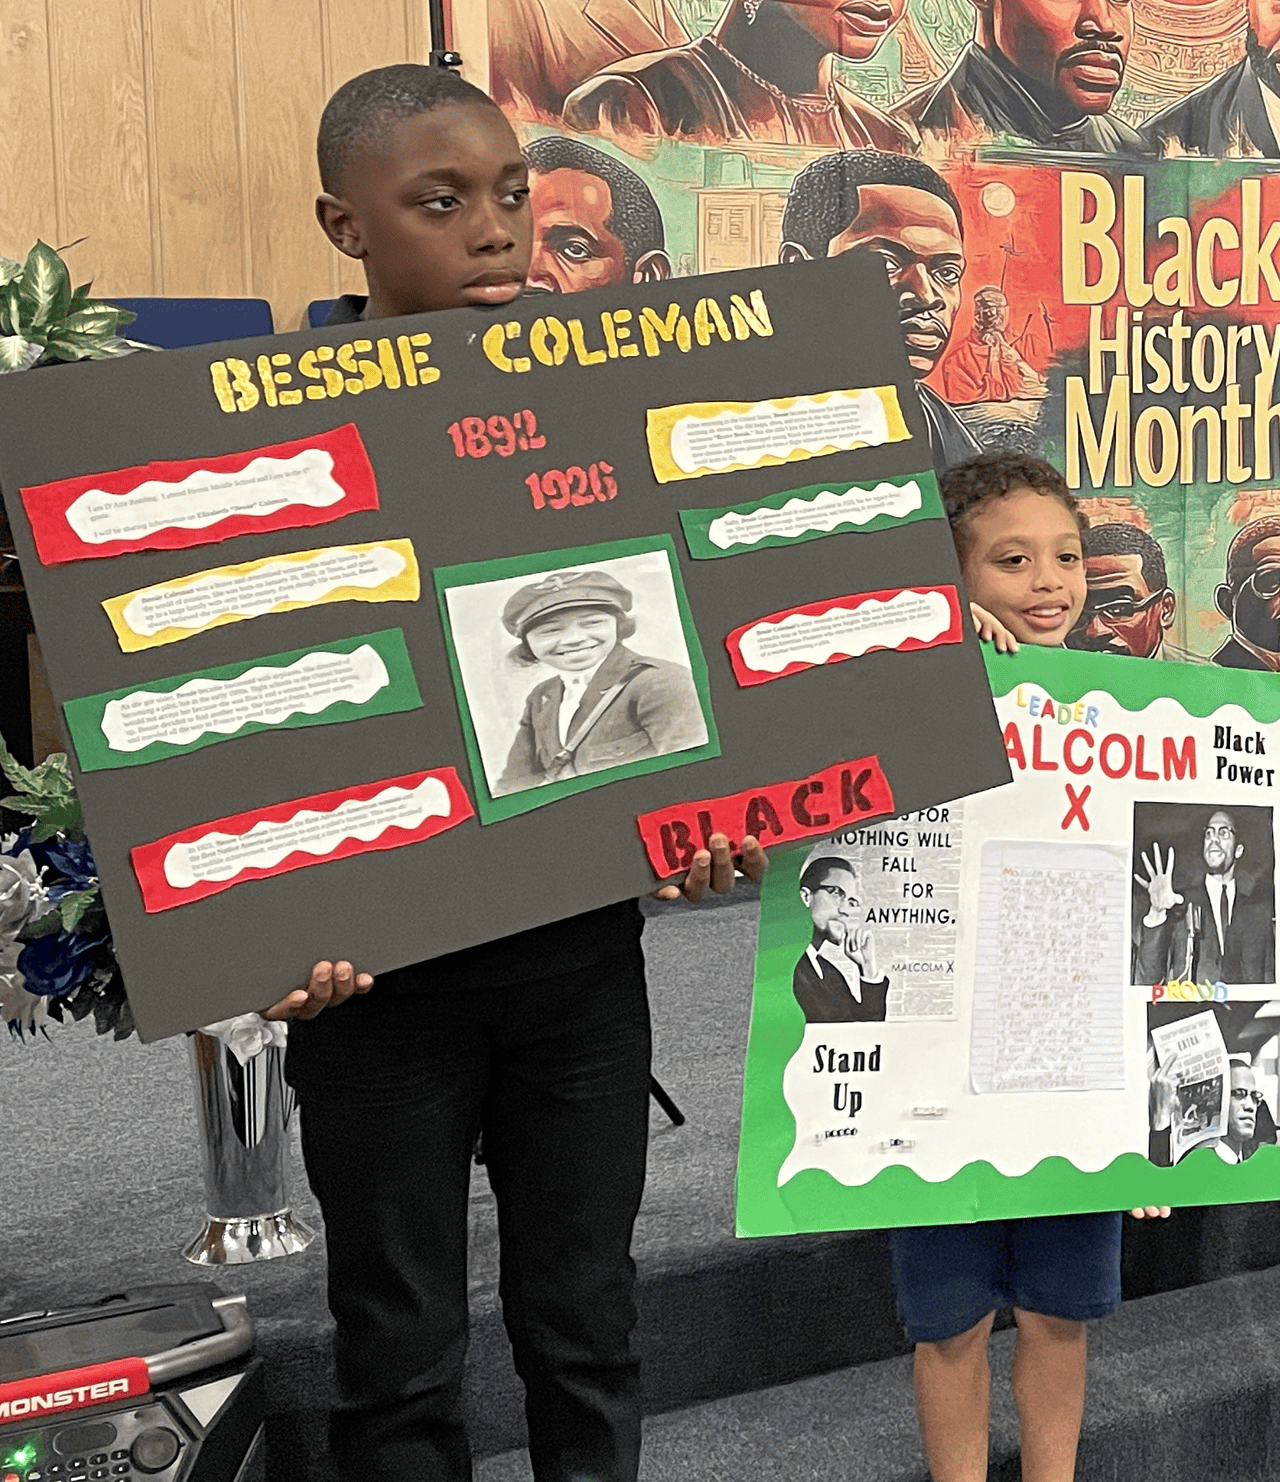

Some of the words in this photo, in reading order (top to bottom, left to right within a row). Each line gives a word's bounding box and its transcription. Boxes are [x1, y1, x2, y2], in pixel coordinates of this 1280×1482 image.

[209, 332, 441, 414] BESSIE
[482, 289, 775, 373] COLEMAN
[447, 409, 547, 459] 1892
[524, 461, 619, 511] 1926
[1017, 687, 1099, 728] LEADER
[1003, 722, 1197, 781] ALCOLM
[1213, 725, 1266, 755] Black
[1216, 756, 1275, 787] Power
[659, 768, 874, 872] BLACK
[918, 808, 950, 823] FOR
[1061, 783, 1091, 832] X
[831, 830, 909, 847] NOTHING
[918, 832, 953, 848] WILL
[882, 857, 917, 873] FALL
[903, 883, 934, 898] FOR
[865, 908, 956, 924] ANYTHING.
[891, 962, 944, 973] MALCOLM
[946, 961, 955, 973] X
[1151, 978, 1229, 1005] PROUD
[813, 1044, 882, 1073] Stand
[833, 1083, 863, 1118] Up
